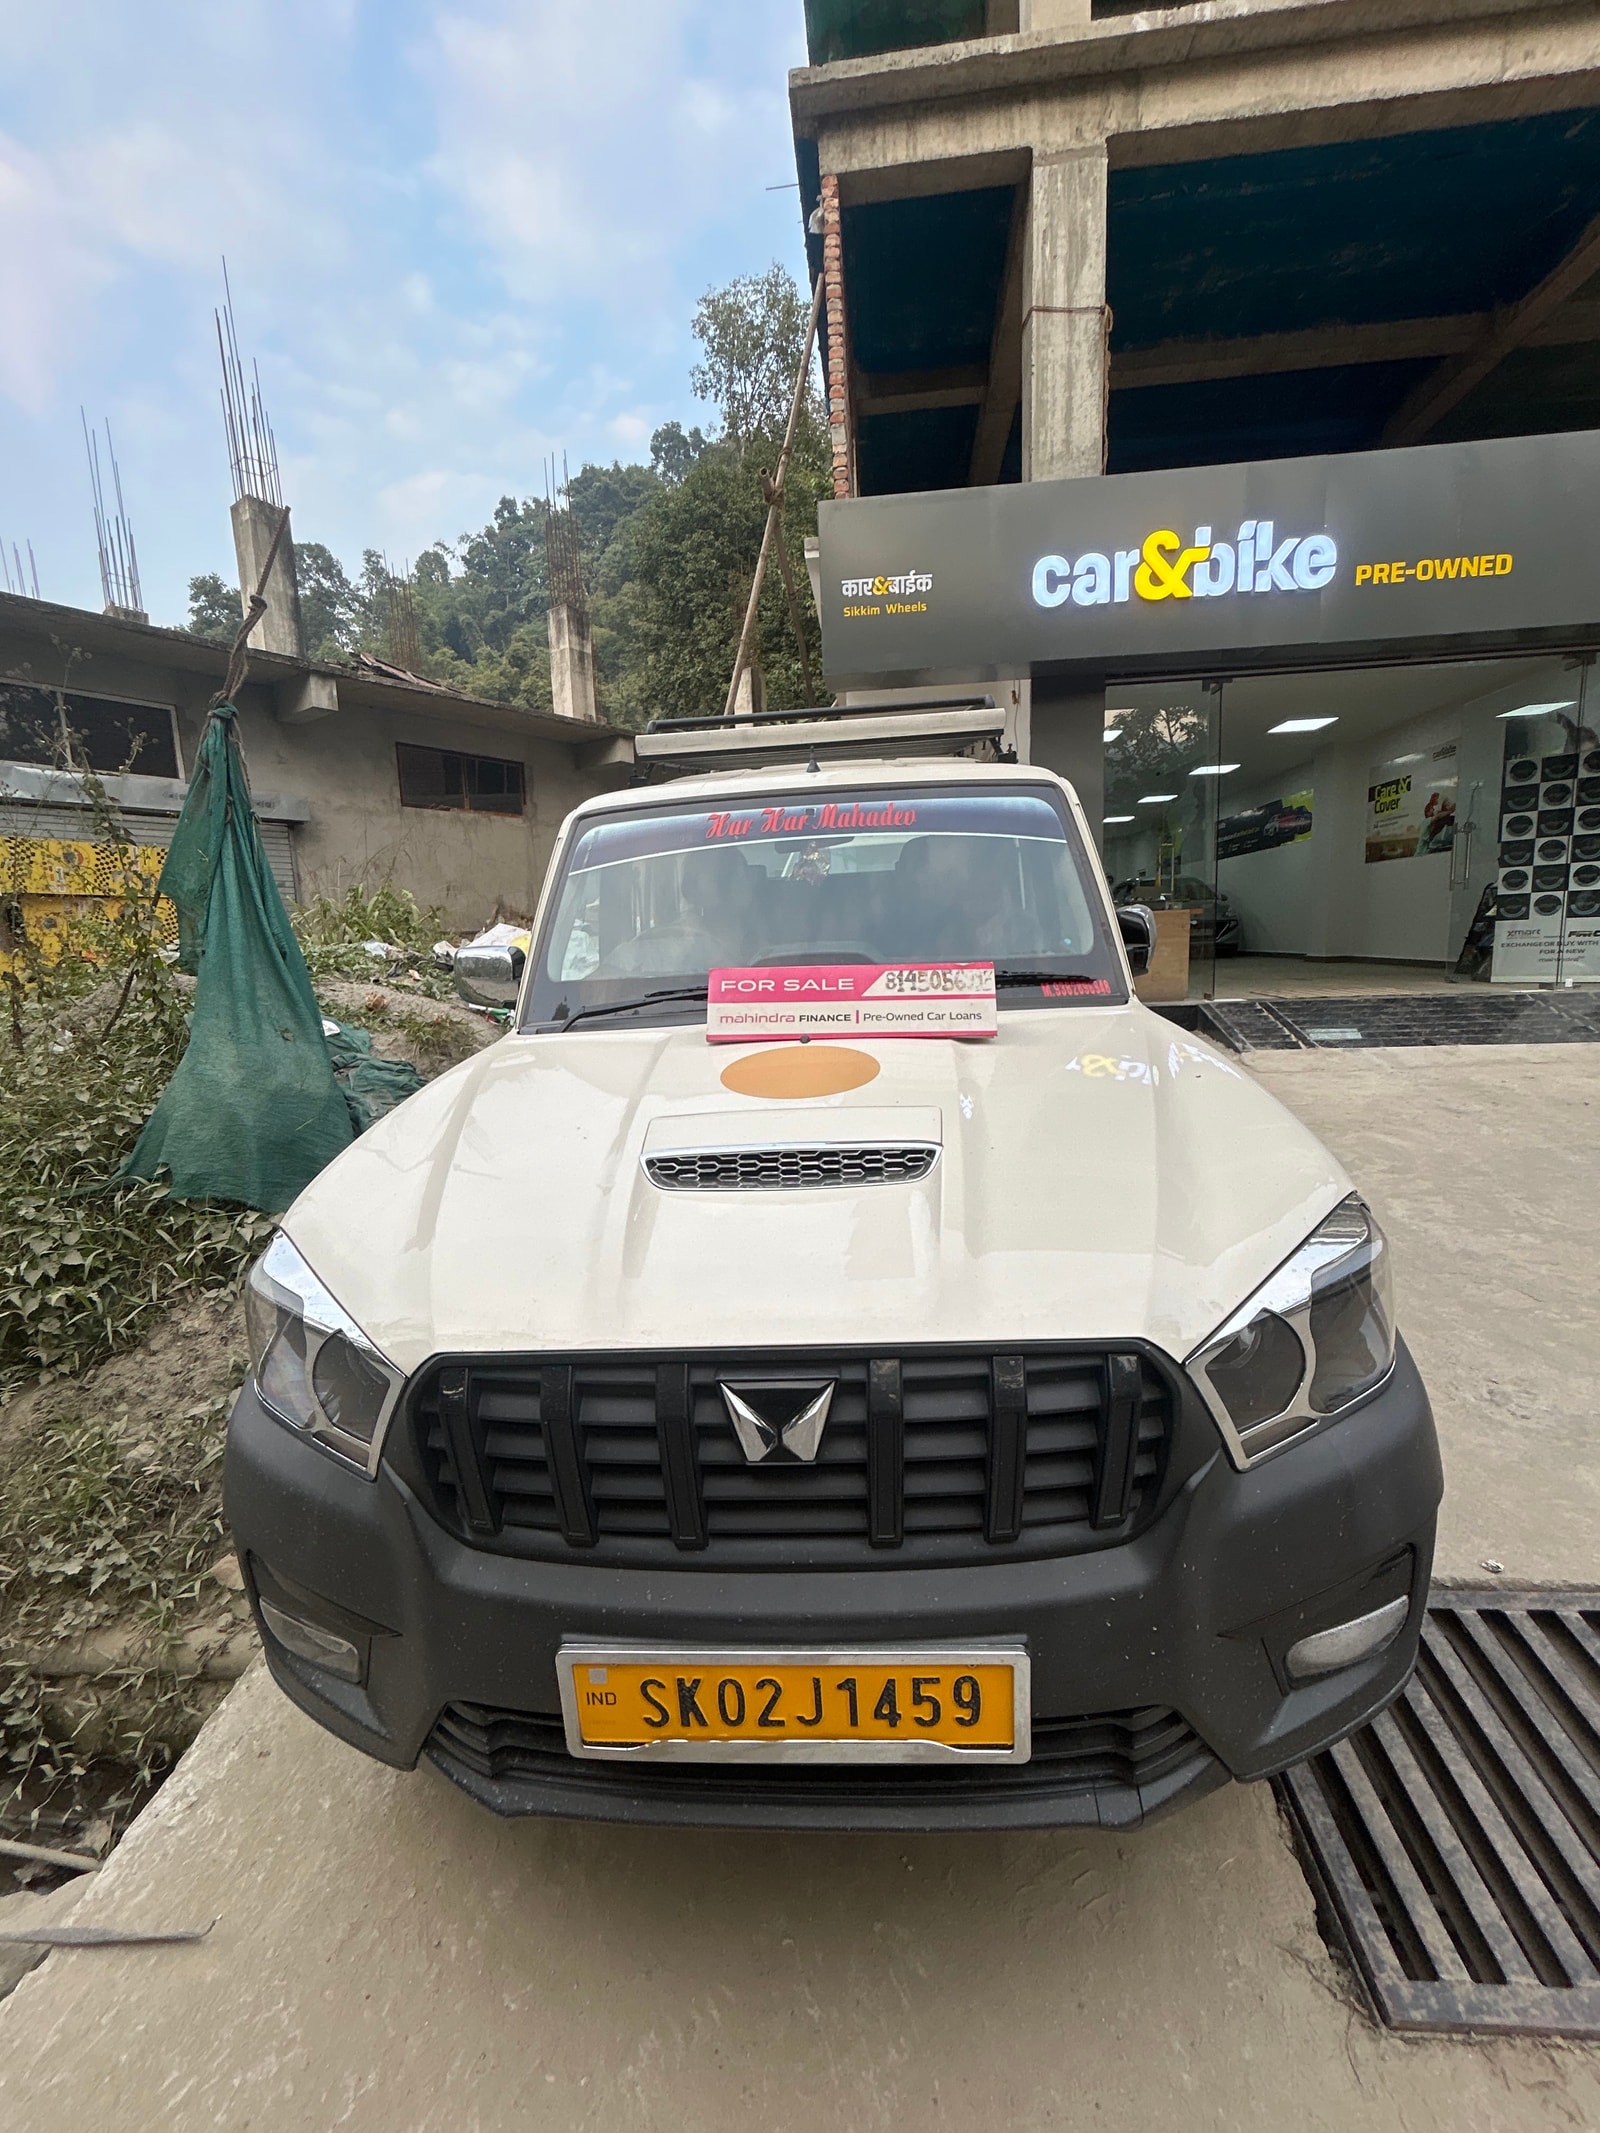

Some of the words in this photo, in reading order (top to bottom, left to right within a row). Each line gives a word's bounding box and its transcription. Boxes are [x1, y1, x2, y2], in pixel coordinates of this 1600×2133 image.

[1031, 519, 1338, 609] car&bike
[1355, 553, 1514, 586] PRE-OWNED
[841, 570, 933, 597] कार&बाईक
[843, 605, 880, 617] Sikkim
[886, 601, 927, 614] Wheels
[1375, 784, 1396, 800] Care
[1374, 797, 1401, 814] Cover
[706, 812, 752, 839] Har
[761, 807, 809, 833] Har
[812, 802, 916, 829] Mahadev
[720, 979, 780, 993] FOR
[783, 978, 854, 992] SALE
[720, 1013, 795, 1024] mahindra
[799, 1013, 851, 1022] FINANCE
[863, 1012, 923, 1022] Pre-Owned
[927, 1011, 946, 1021] Car
[949, 1011, 982, 1021] Loans
[586, 1692, 617, 1706] IND
[638, 1675, 982, 1728] SK02J1459
